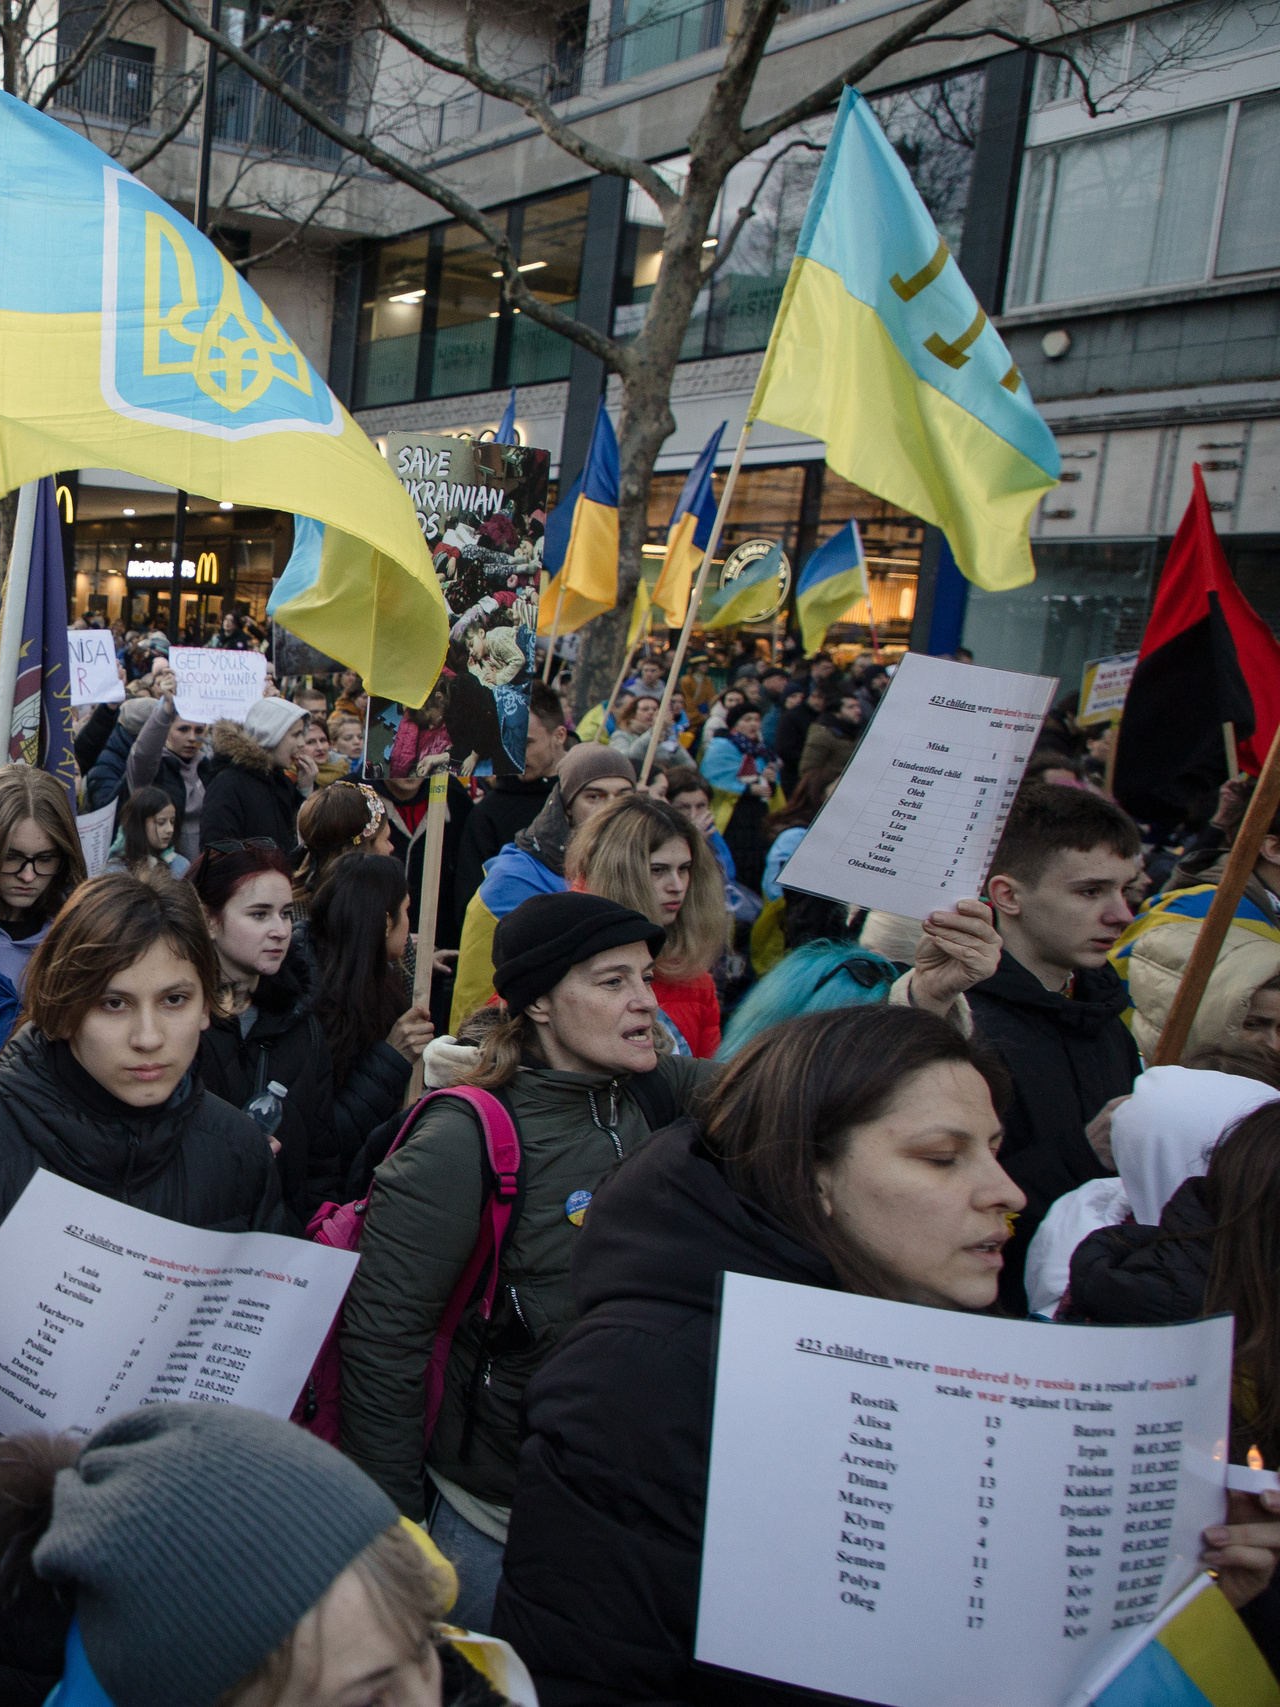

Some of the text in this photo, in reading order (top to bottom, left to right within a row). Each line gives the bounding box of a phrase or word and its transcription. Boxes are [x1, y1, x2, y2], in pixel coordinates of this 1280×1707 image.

[397, 446, 451, 478] SAVE
[175, 652, 250, 672] GET YOUR
[223, 672, 258, 686] HANDS
[930, 695, 945, 705] 423
[945, 699, 976, 711] children
[977, 705, 992, 714] were
[926, 741, 950, 753] Misha
[910, 775, 934, 787] Renat
[944, 769, 962, 779] child
[898, 798, 923, 810] Serhii
[891, 809, 917, 821] Oryna
[888, 821, 907, 831] Liza
[881, 831, 904, 843] Vania
[868, 851, 891, 863] Vania
[875, 842, 895, 853] Ania
[65, 1223, 85, 1236] 423
[84, 1230, 124, 1254] children
[125, 1248, 148, 1262] were
[78, 1264, 100, 1279] Ania
[142, 1268, 183, 1285] scale war
[63, 1271, 102, 1293] Veronika
[54, 1282, 94, 1304] Karolina
[36, 1301, 85, 1328] Marharyta
[43, 1317, 65, 1334] Yeva
[37, 1328, 57, 1344] Vika
[21, 1348, 45, 1366] Varia
[25, 1337, 53, 1357] Polina
[11, 1357, 39, 1377] Danys
[795, 1336, 822, 1351] 423
[826, 1343, 889, 1365] children
[893, 1356, 931, 1372] were
[933, 1364, 1009, 1385] murdered
[1013, 1373, 1030, 1390] by
[1035, 1377, 1076, 1392] russia
[1078, 1381, 1092, 1392] as
[1094, 1383, 1103, 1392] a
[1104, 1379, 1136, 1392] result
[1137, 1379, 1150, 1392] of
[39, 1385, 58, 1400] girl
[935, 1383, 1113, 1412] scale war against Ukraine
[23, 1402, 47, 1420] child
[849, 1391, 899, 1412] Rostik
[984, 1415, 1002, 1430] 13
[853, 1413, 892, 1431] Alisa
[986, 1435, 996, 1449] 9
[848, 1431, 893, 1451] Sasha
[984, 1456, 995, 1469] 4
[839, 1451, 899, 1475] Arseniy
[979, 1475, 997, 1490] 13
[847, 1471, 889, 1491] Dima
[978, 1496, 995, 1510] 13
[837, 1489, 1104, 1538] Matvey 9 Bucha
[843, 1510, 1102, 1558] Klym 4 Bucha
[839, 1530, 1095, 1580] Katya 11 Kyiv
[836, 1550, 1093, 1600] Semen 5 Kyiv
[838, 1569, 1091, 1621] Polya 11 Kyiv
[839, 1590, 1089, 1641] Oleg 17 Kyiv
